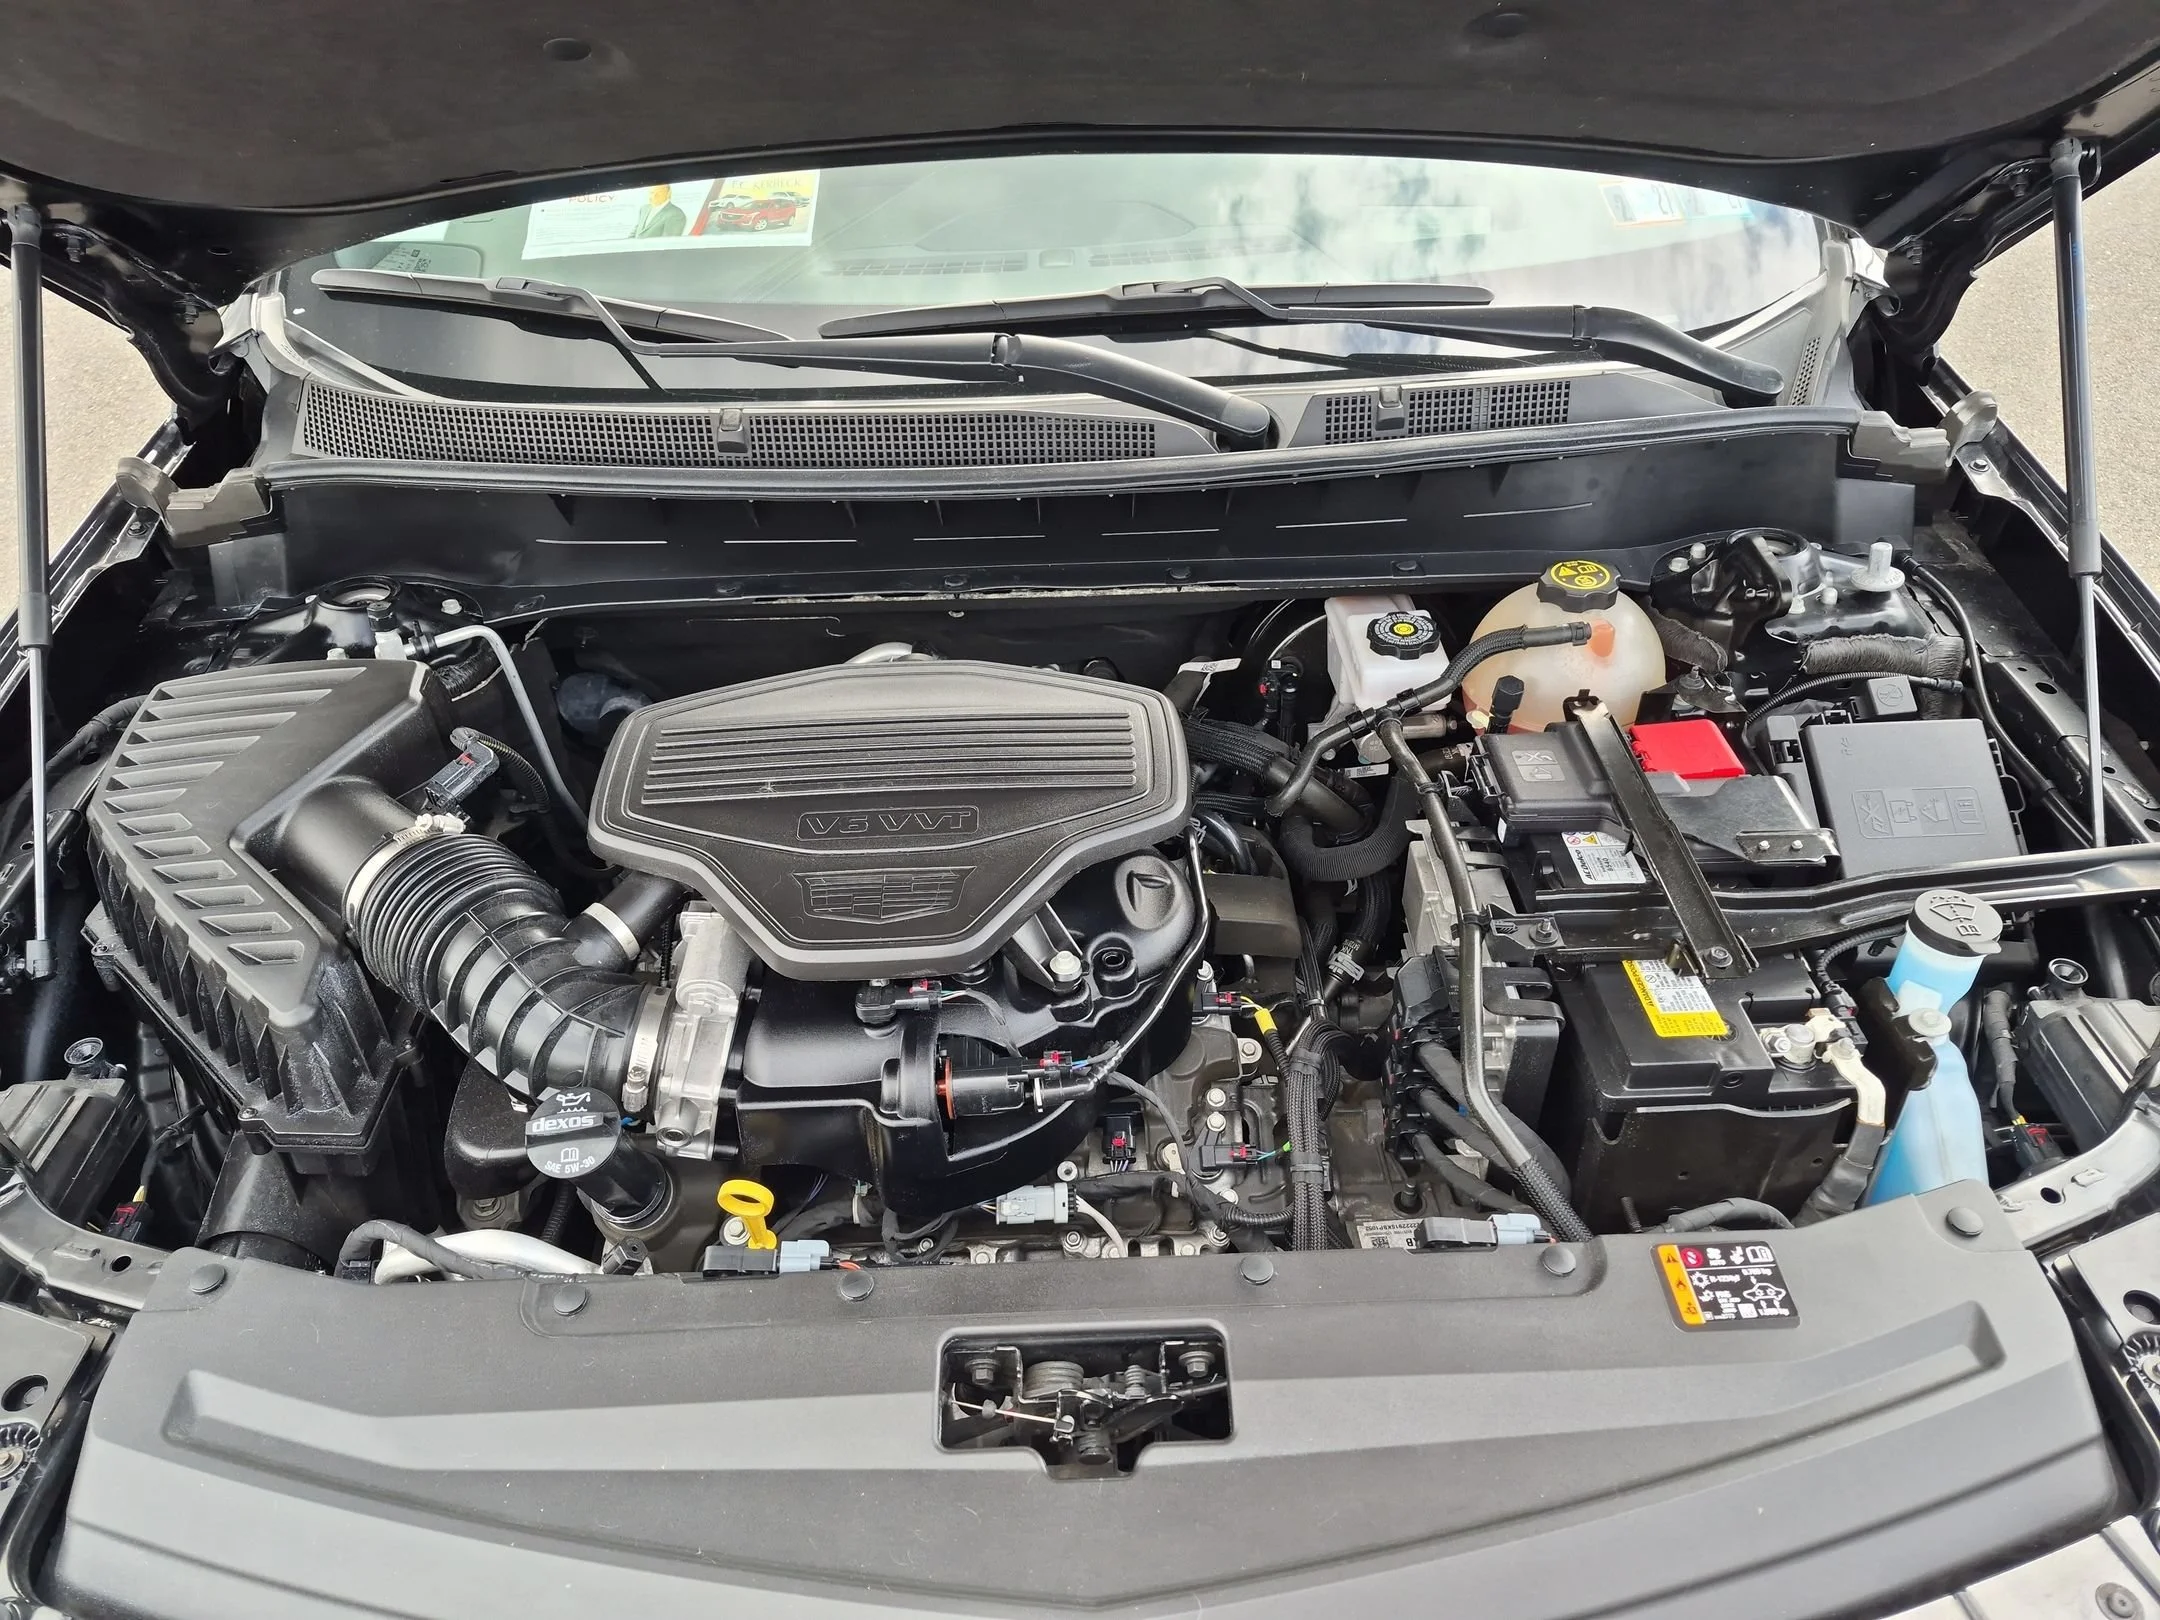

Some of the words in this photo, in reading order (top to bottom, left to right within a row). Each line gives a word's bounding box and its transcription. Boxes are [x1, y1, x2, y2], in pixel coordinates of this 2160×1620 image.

[806, 815, 869, 835] V6
[878, 811, 971, 832] VVT
[532, 1115, 597, 1133] dexos
[544, 1160, 562, 1174] SAE
[564, 1155, 595, 1174] 5W-30
